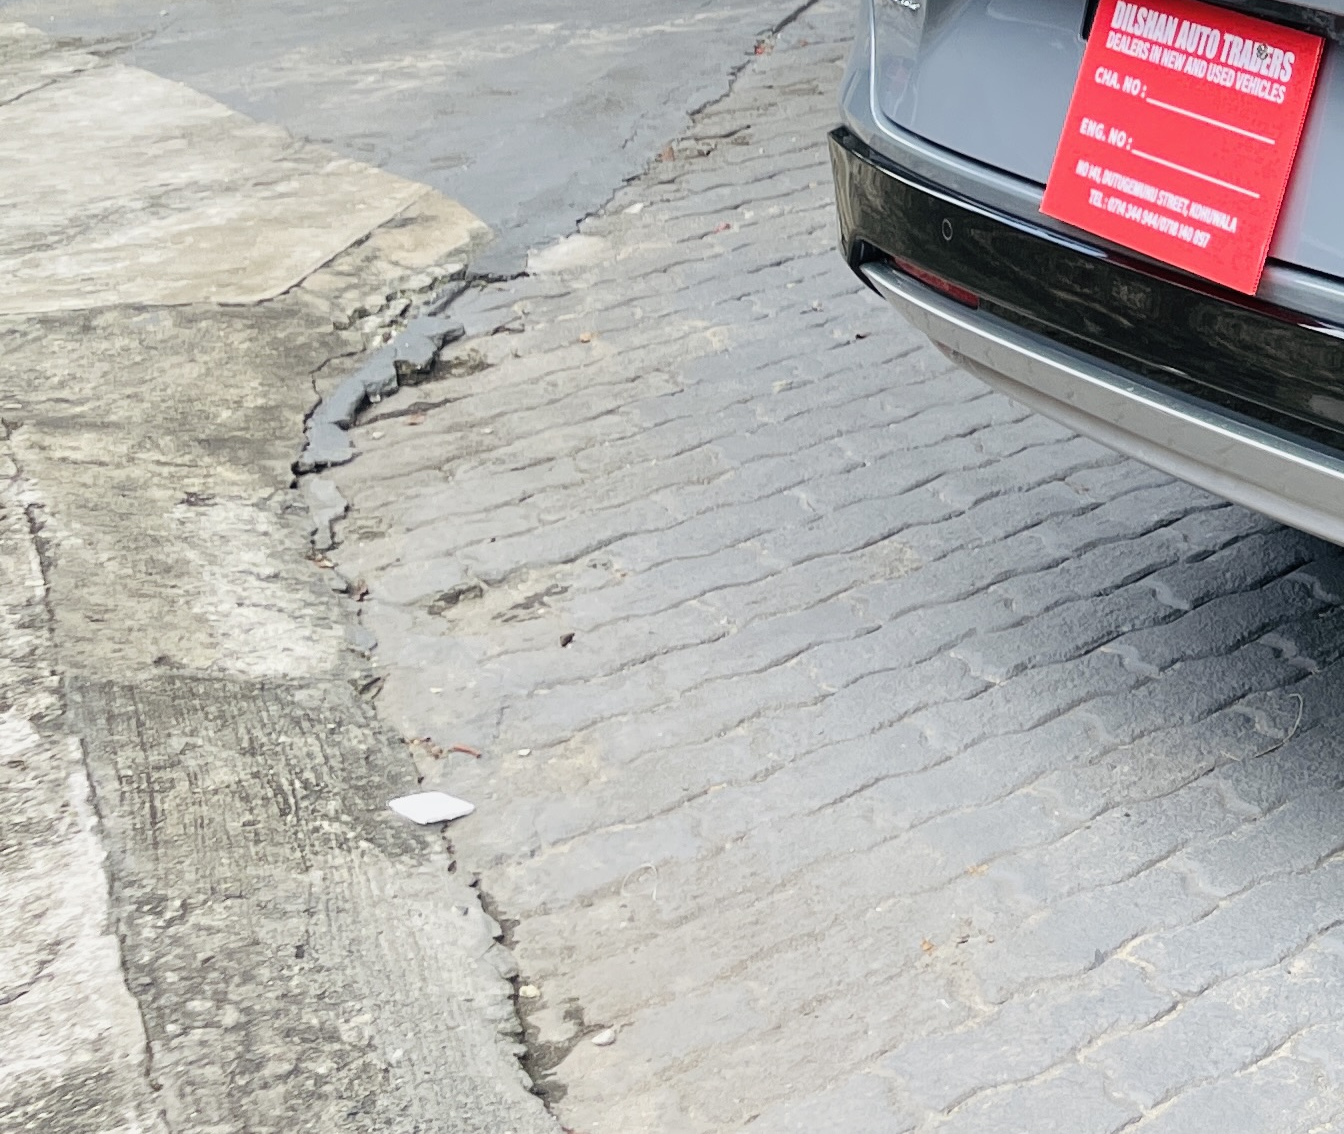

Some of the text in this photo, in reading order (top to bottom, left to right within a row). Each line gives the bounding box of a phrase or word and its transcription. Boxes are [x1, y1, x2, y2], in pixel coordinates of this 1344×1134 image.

[1106, 31, 1286, 104] DEALERS IN NEW AND USED VEHICLES
[1110, 0, 1295, 83] DILSHAN AUTO TRADERS
[1094, 66, 1121, 91] CHA.
[1122, 75, 1142, 96] NO
[1079, 117, 1106, 141] ENG.
[1108, 127, 1127, 148] NO
